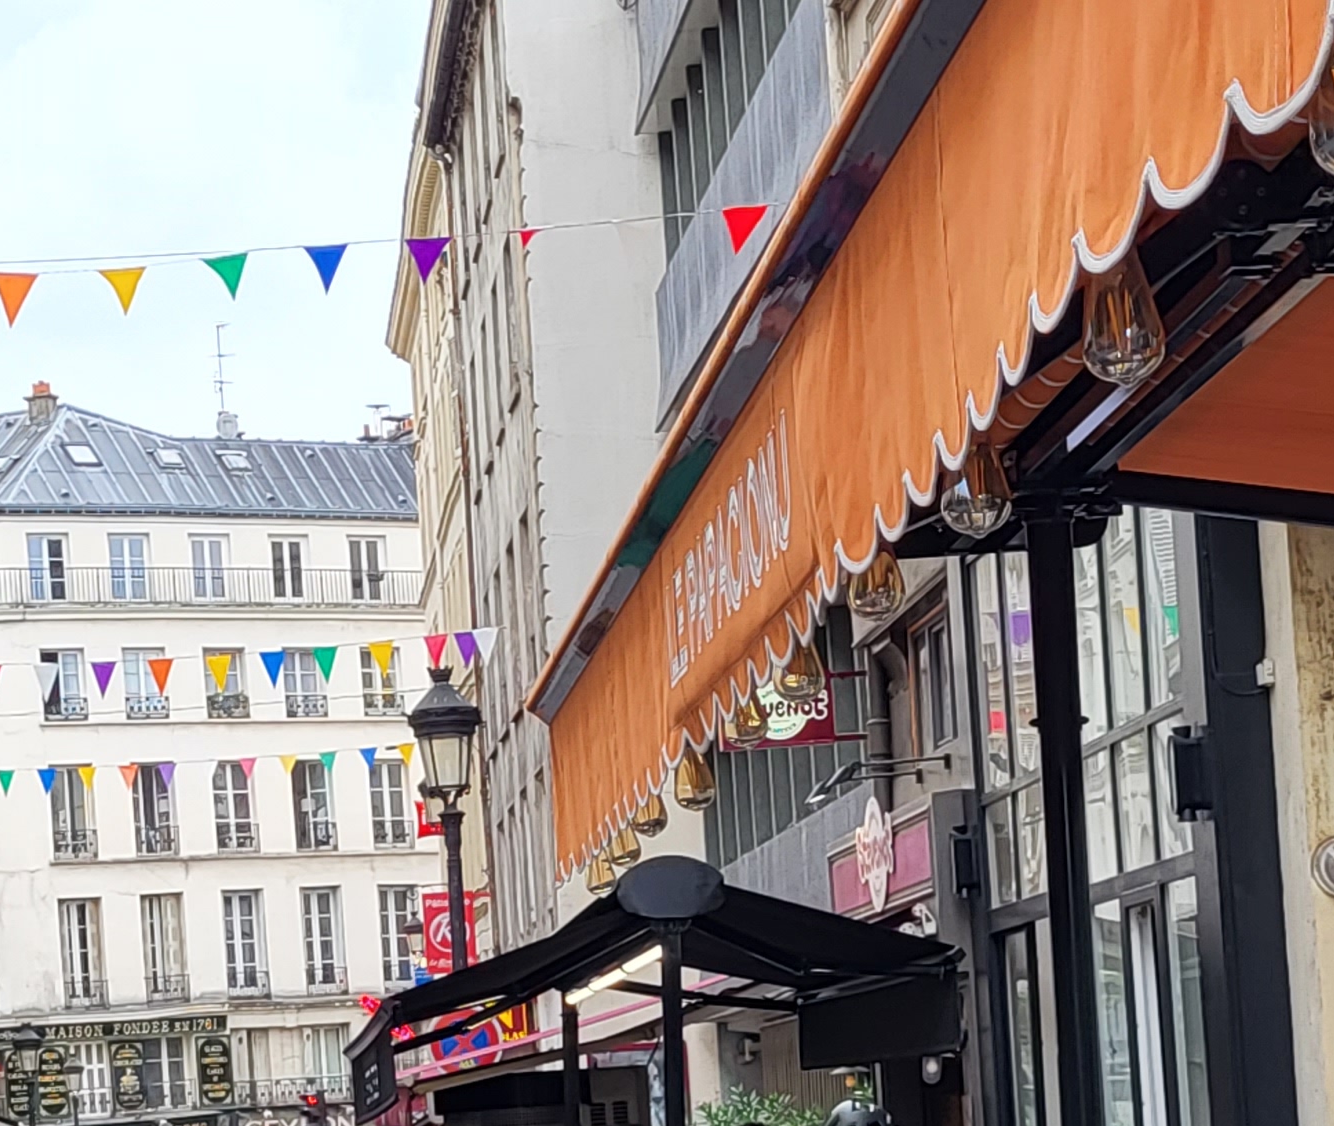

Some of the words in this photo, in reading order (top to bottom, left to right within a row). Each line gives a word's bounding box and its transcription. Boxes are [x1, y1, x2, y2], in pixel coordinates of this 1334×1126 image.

[666, 567, 689, 689] LE
[685, 408, 792, 663] PAPACIONU
[45, 1024, 104, 1040] MAISON
